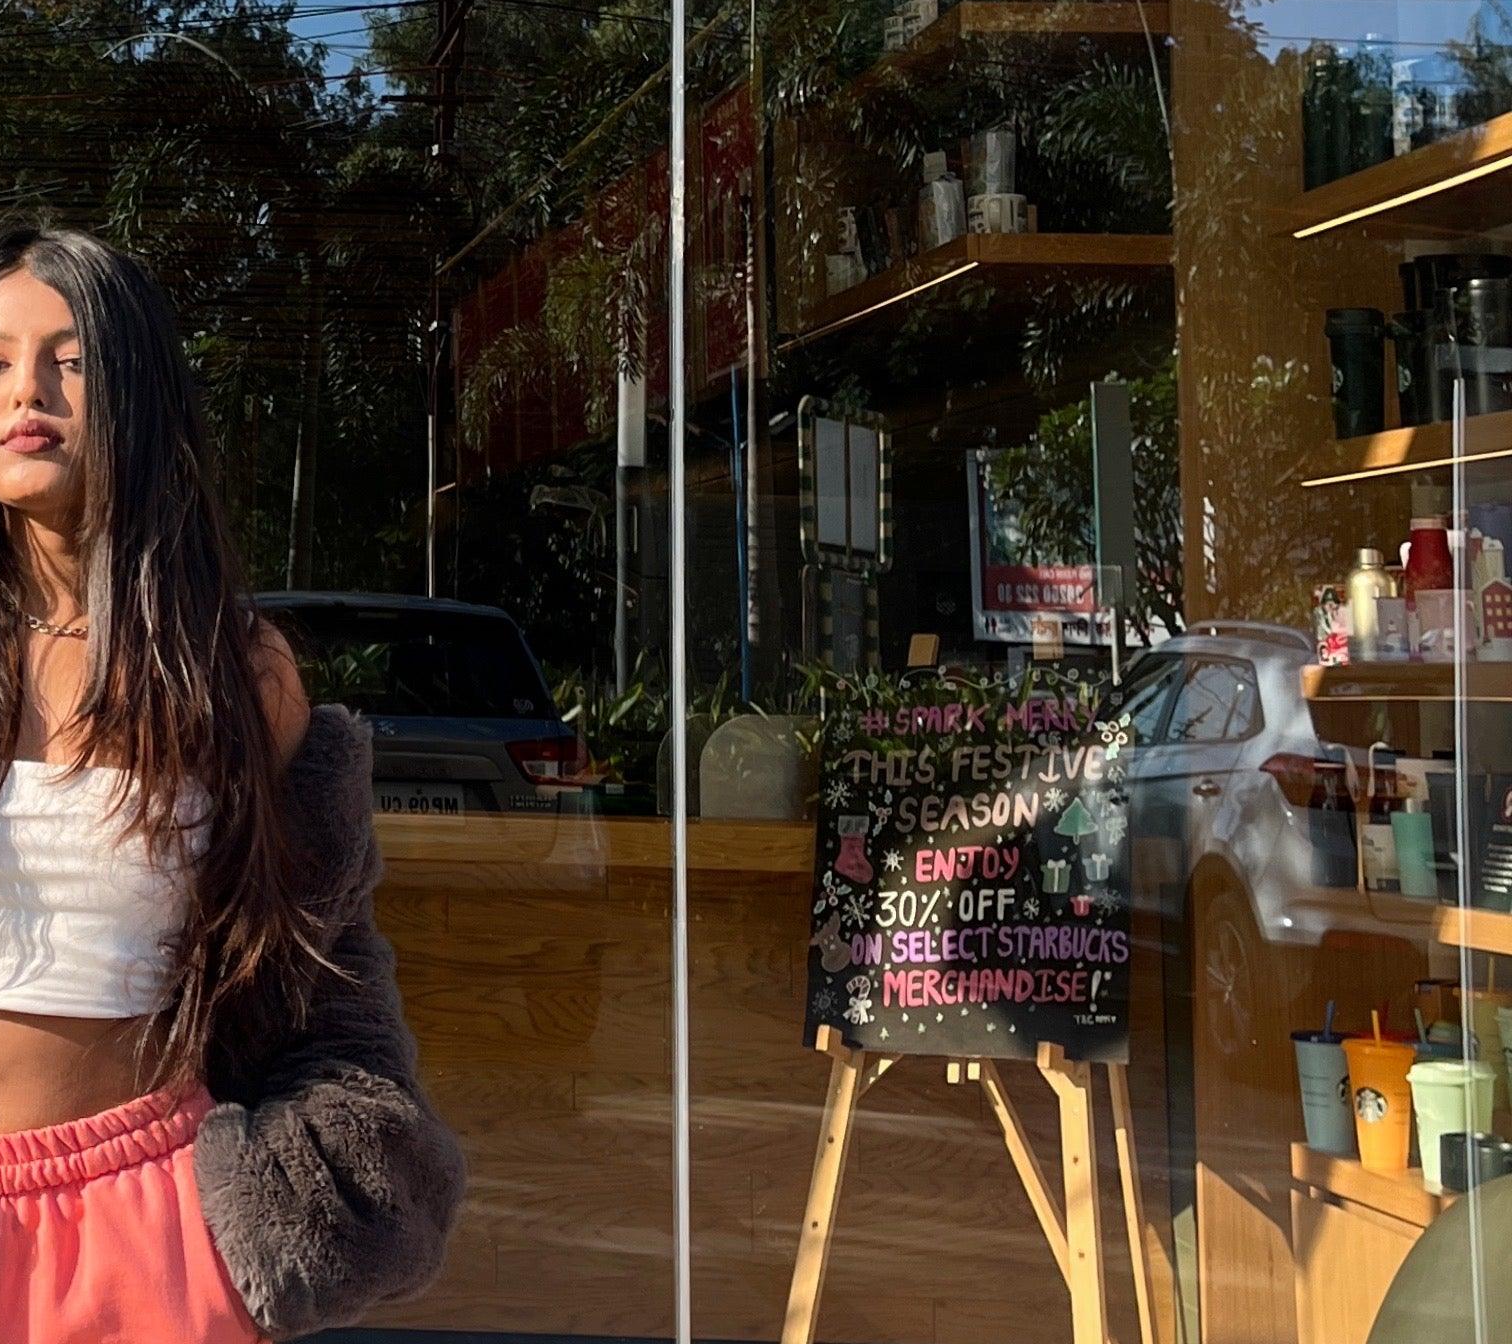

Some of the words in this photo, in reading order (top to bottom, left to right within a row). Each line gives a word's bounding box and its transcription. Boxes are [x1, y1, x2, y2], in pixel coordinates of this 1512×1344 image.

[1006, 699, 1099, 735] MERRY
[841, 749, 938, 786] THIS
[951, 746, 1104, 783] FESTIVE
[894, 791, 1038, 833] SEASON
[914, 845, 1020, 884] ENJOY
[875, 889, 941, 927] 30%
[958, 888, 1016, 923] OFF
[851, 931, 882, 965] ON
[891, 926, 995, 964] SELECT
[996, 924, 1129, 964] STARBUCKS
[881, 968, 1103, 1015] MERCHANDISE!
